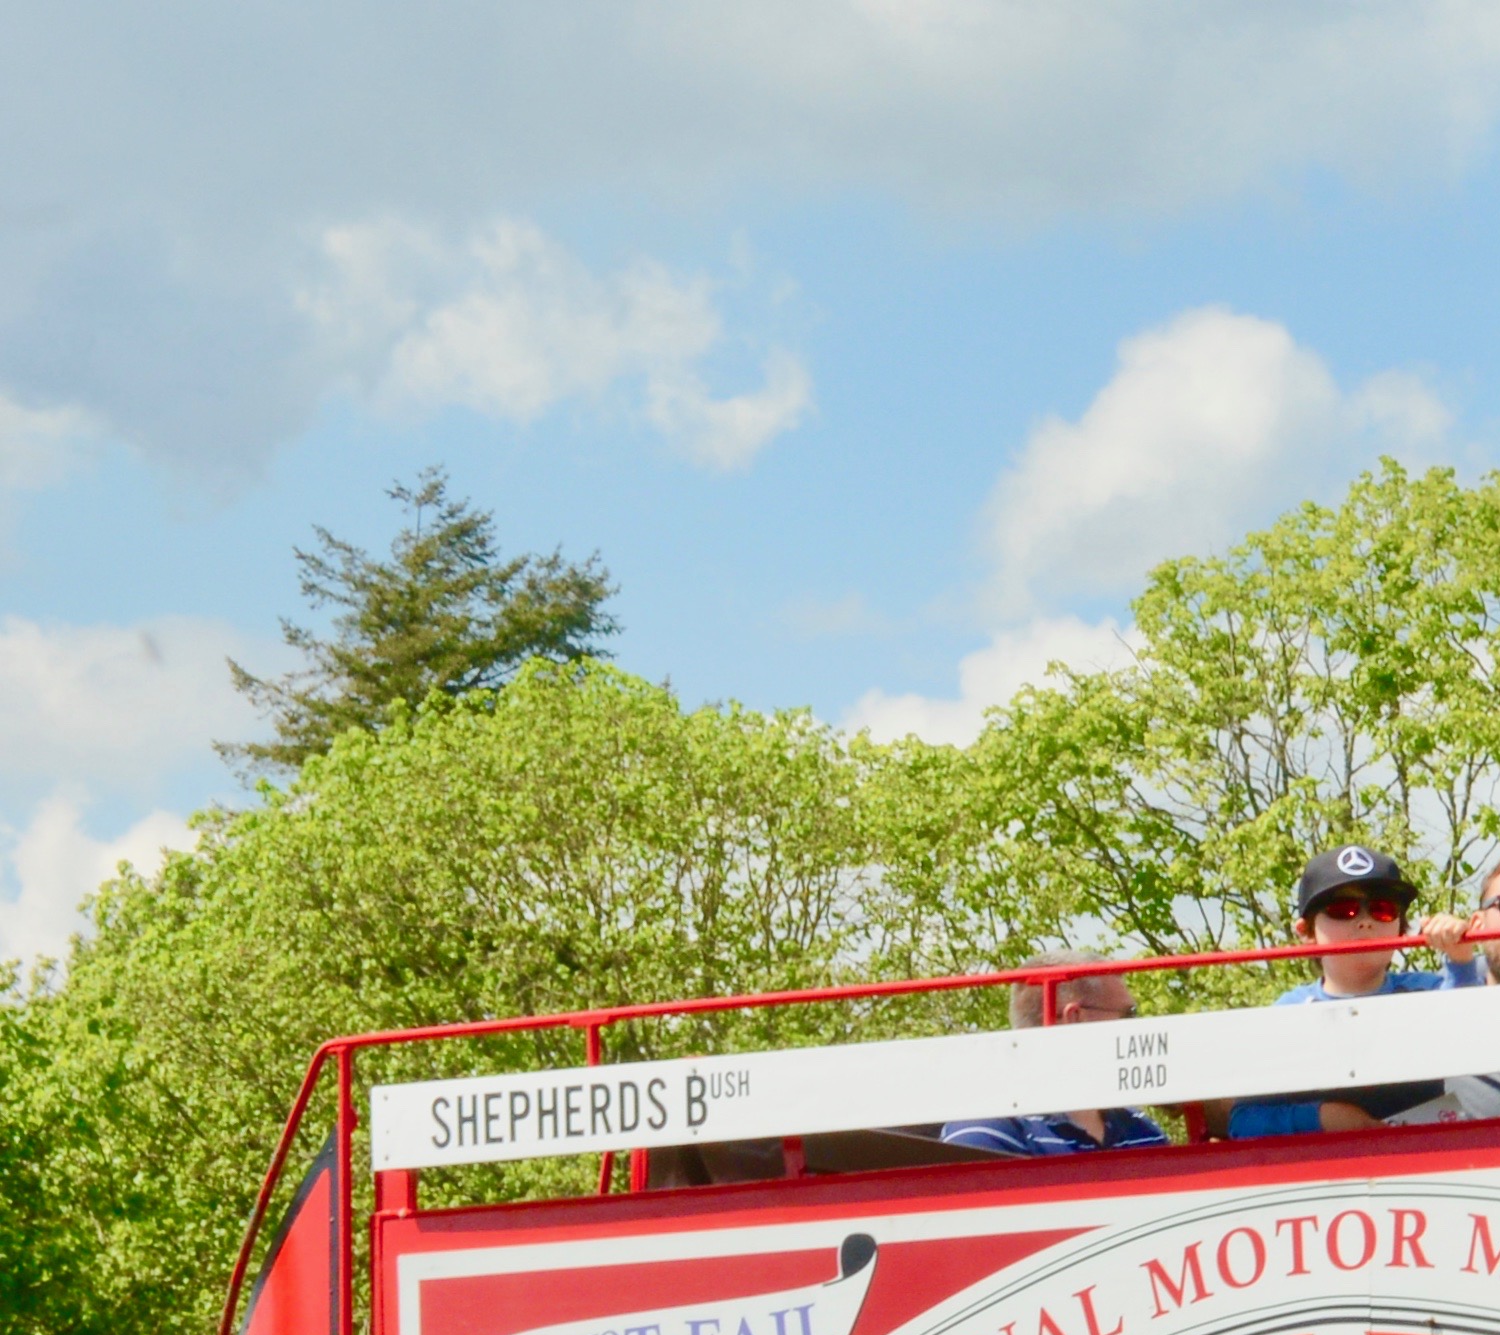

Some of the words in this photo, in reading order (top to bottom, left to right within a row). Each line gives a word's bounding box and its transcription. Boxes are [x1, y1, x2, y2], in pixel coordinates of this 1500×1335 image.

[1116, 1032, 1168, 1060] LAWN
[1118, 1064, 1167, 1091] ROAD
[431, 1078, 668, 1148] SHEPHERDS
[1140, 1208, 1433, 1318] MOTOR
